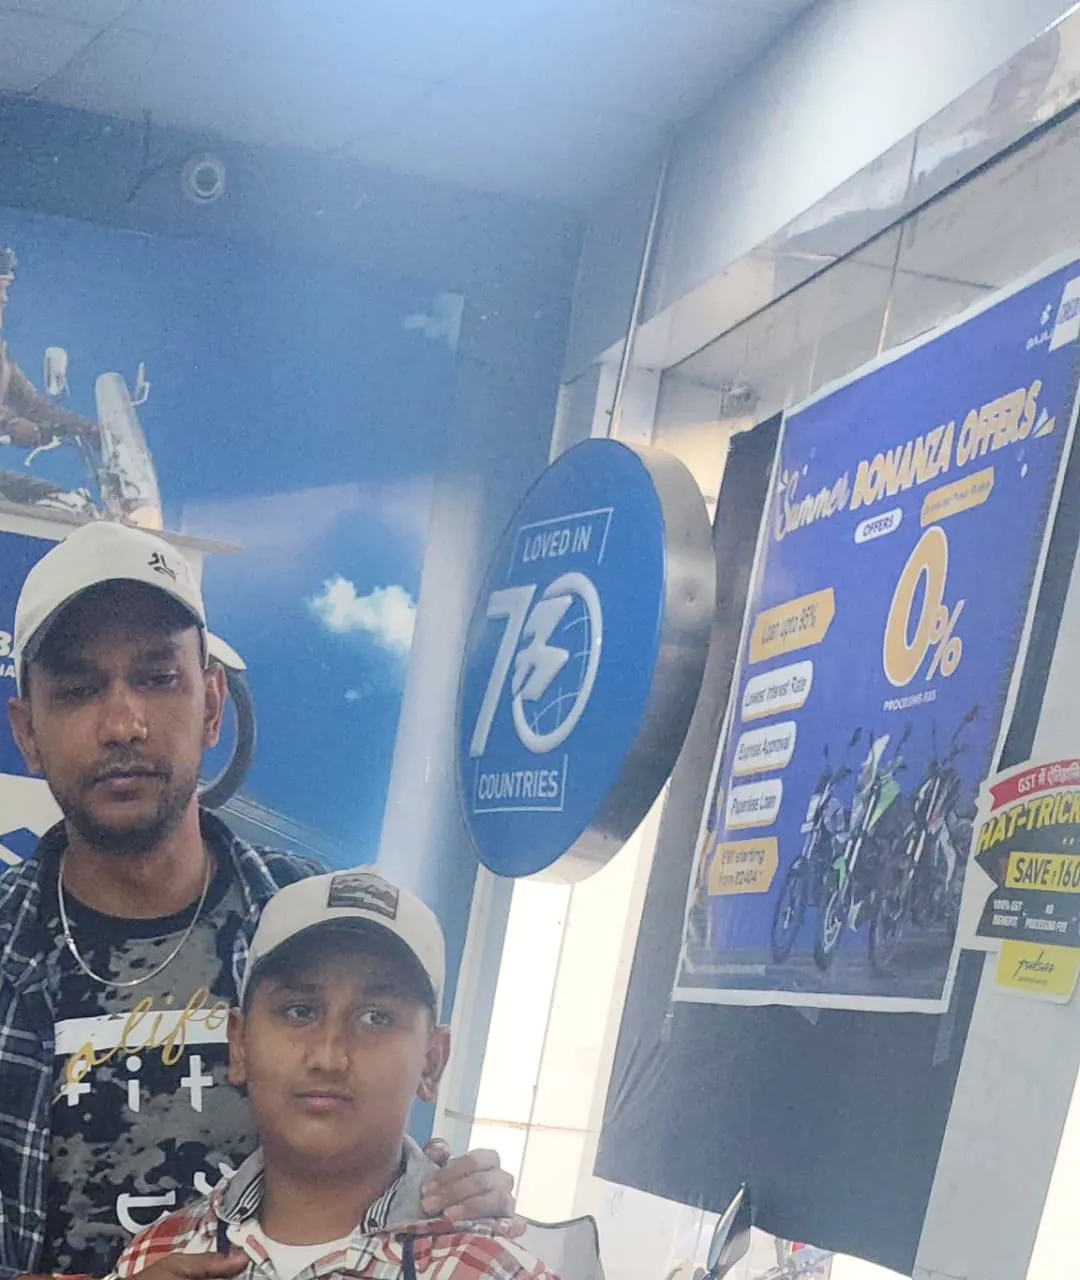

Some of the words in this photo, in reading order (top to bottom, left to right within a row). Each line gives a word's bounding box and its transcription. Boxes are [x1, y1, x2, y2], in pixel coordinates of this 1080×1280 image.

[849, 420, 955, 511] BONANZA
[956, 379, 1042, 467] OFFERS
[522, 528, 572, 562] LOVED
[571, 525, 592, 553] IN
[883, 526, 966, 687] 0%
[477, 768, 560, 801] COUNTRIES
[1013, 857, 1052, 885] SAVE
